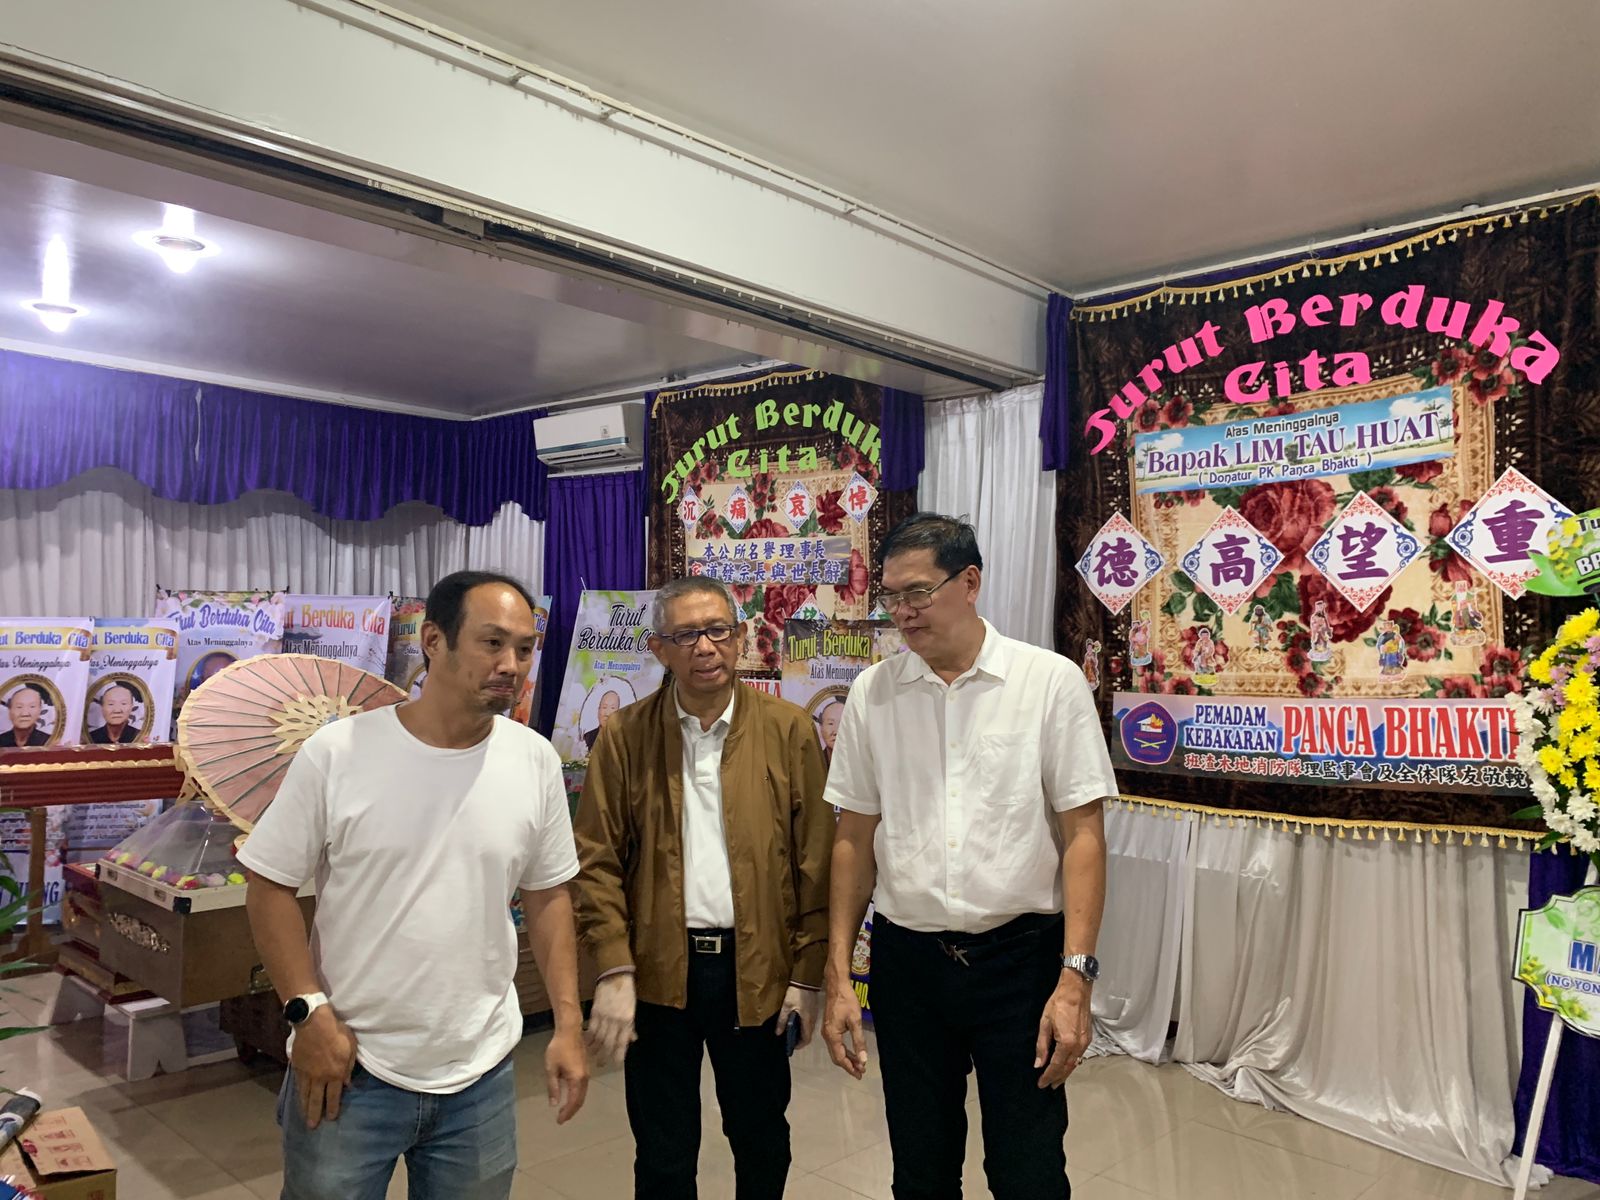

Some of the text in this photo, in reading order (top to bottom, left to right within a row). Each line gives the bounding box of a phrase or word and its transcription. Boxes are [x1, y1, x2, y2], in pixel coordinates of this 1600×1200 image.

[1084, 285, 1561, 455] Turut Berduka
[1224, 351, 1372, 404] Cita
[1226, 413, 1339, 439] Atas Meninggalnya
[661, 399, 882, 504] Turut Berduk
[1148, 411, 1439, 477] Bapak LIM TAU HUAT
[727, 444, 817, 477] Cita
[1209, 472, 1252, 484] Donatur
[1259, 466, 1275, 479] PK
[1282, 464, 1315, 478] Panca
[1322, 456, 1359, 473] Bhakti
[199, 604, 250, 628] Berduka
[253, 608, 275, 635] Cita
[302, 604, 354, 629] Berduka
[361, 607, 385, 636] Cita
[610, 603, 647, 627] Turut
[15, 631, 62, 645] Berduka
[68, 633, 88, 648] Cita
[104, 632, 149, 645] Berduka
[156, 633, 174, 647] Cita
[204, 637, 253, 648] Meninggalnya
[304, 640, 358, 660] Meninggalnya
[578, 627, 635, 651] Berduka
[788, 629, 871, 662] Turut Berduka
[810, 664, 825, 679] Atas
[1184, 727, 1277, 752] KEBAKARAN
[1195, 705, 1267, 727] PEMADAM
[1282, 706, 1375, 757] PANCA
[1384, 707, 1521, 760] BHAKTI
